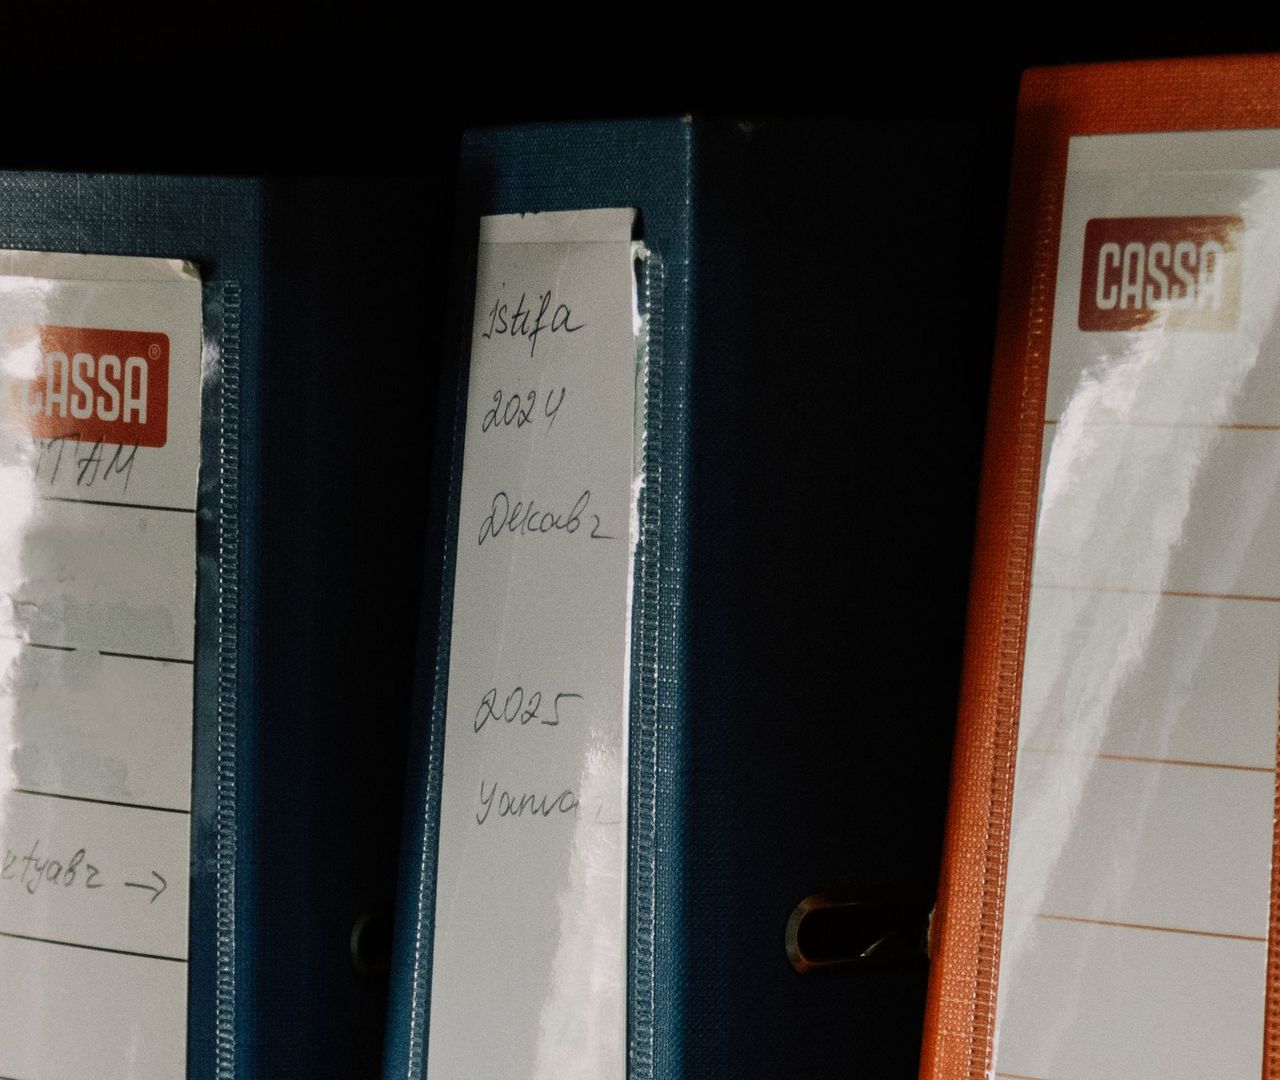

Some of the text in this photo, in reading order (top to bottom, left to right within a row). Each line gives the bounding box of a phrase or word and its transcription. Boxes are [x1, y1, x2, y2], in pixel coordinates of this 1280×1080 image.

[1095, 239, 1224, 311] CASSA
[481, 386, 567, 436] 2024
[473, 685, 585, 734] 2025
